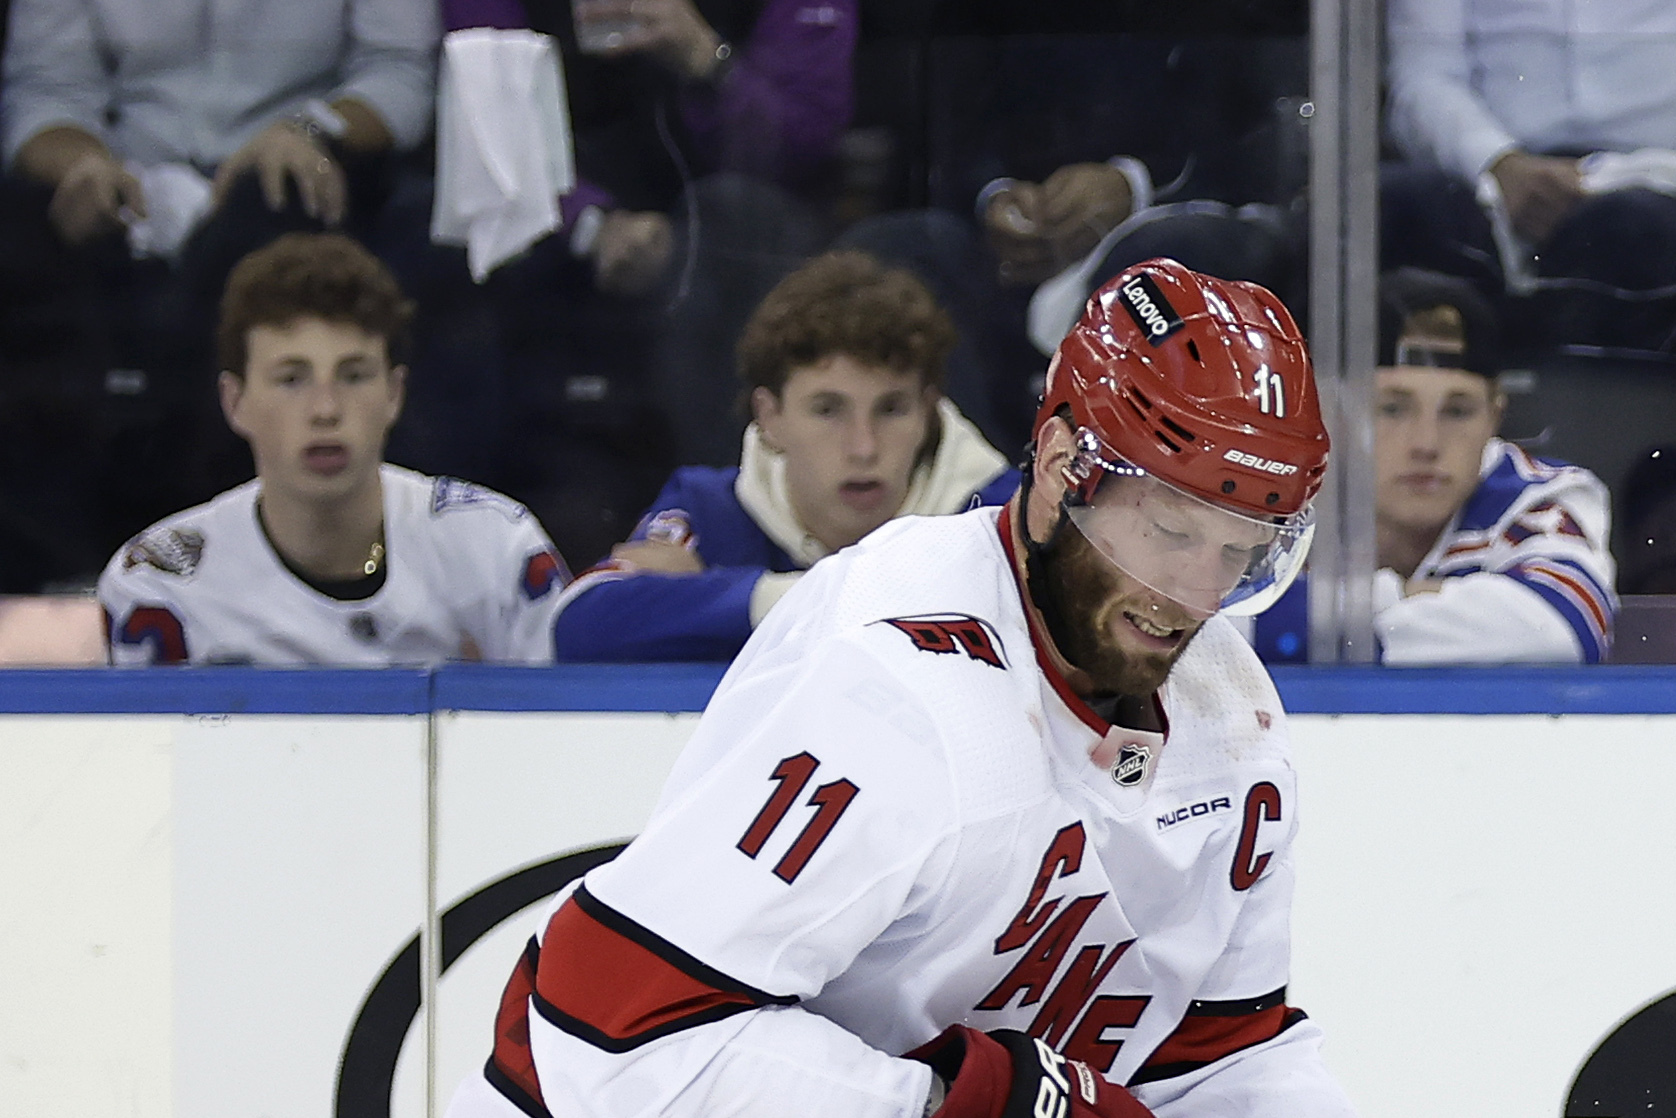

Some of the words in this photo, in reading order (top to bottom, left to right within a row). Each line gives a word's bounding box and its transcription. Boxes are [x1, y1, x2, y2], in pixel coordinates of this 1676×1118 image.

[1122, 277, 1169, 335] Lenovo
[1254, 363, 1285, 418] 11
[1223, 449, 1298, 476] BAUER
[735, 750, 861, 886] 11
[1157, 797, 1231, 830] NUCOR
[1229, 780, 1282, 892] C
[973, 819, 1154, 1075] CANE
